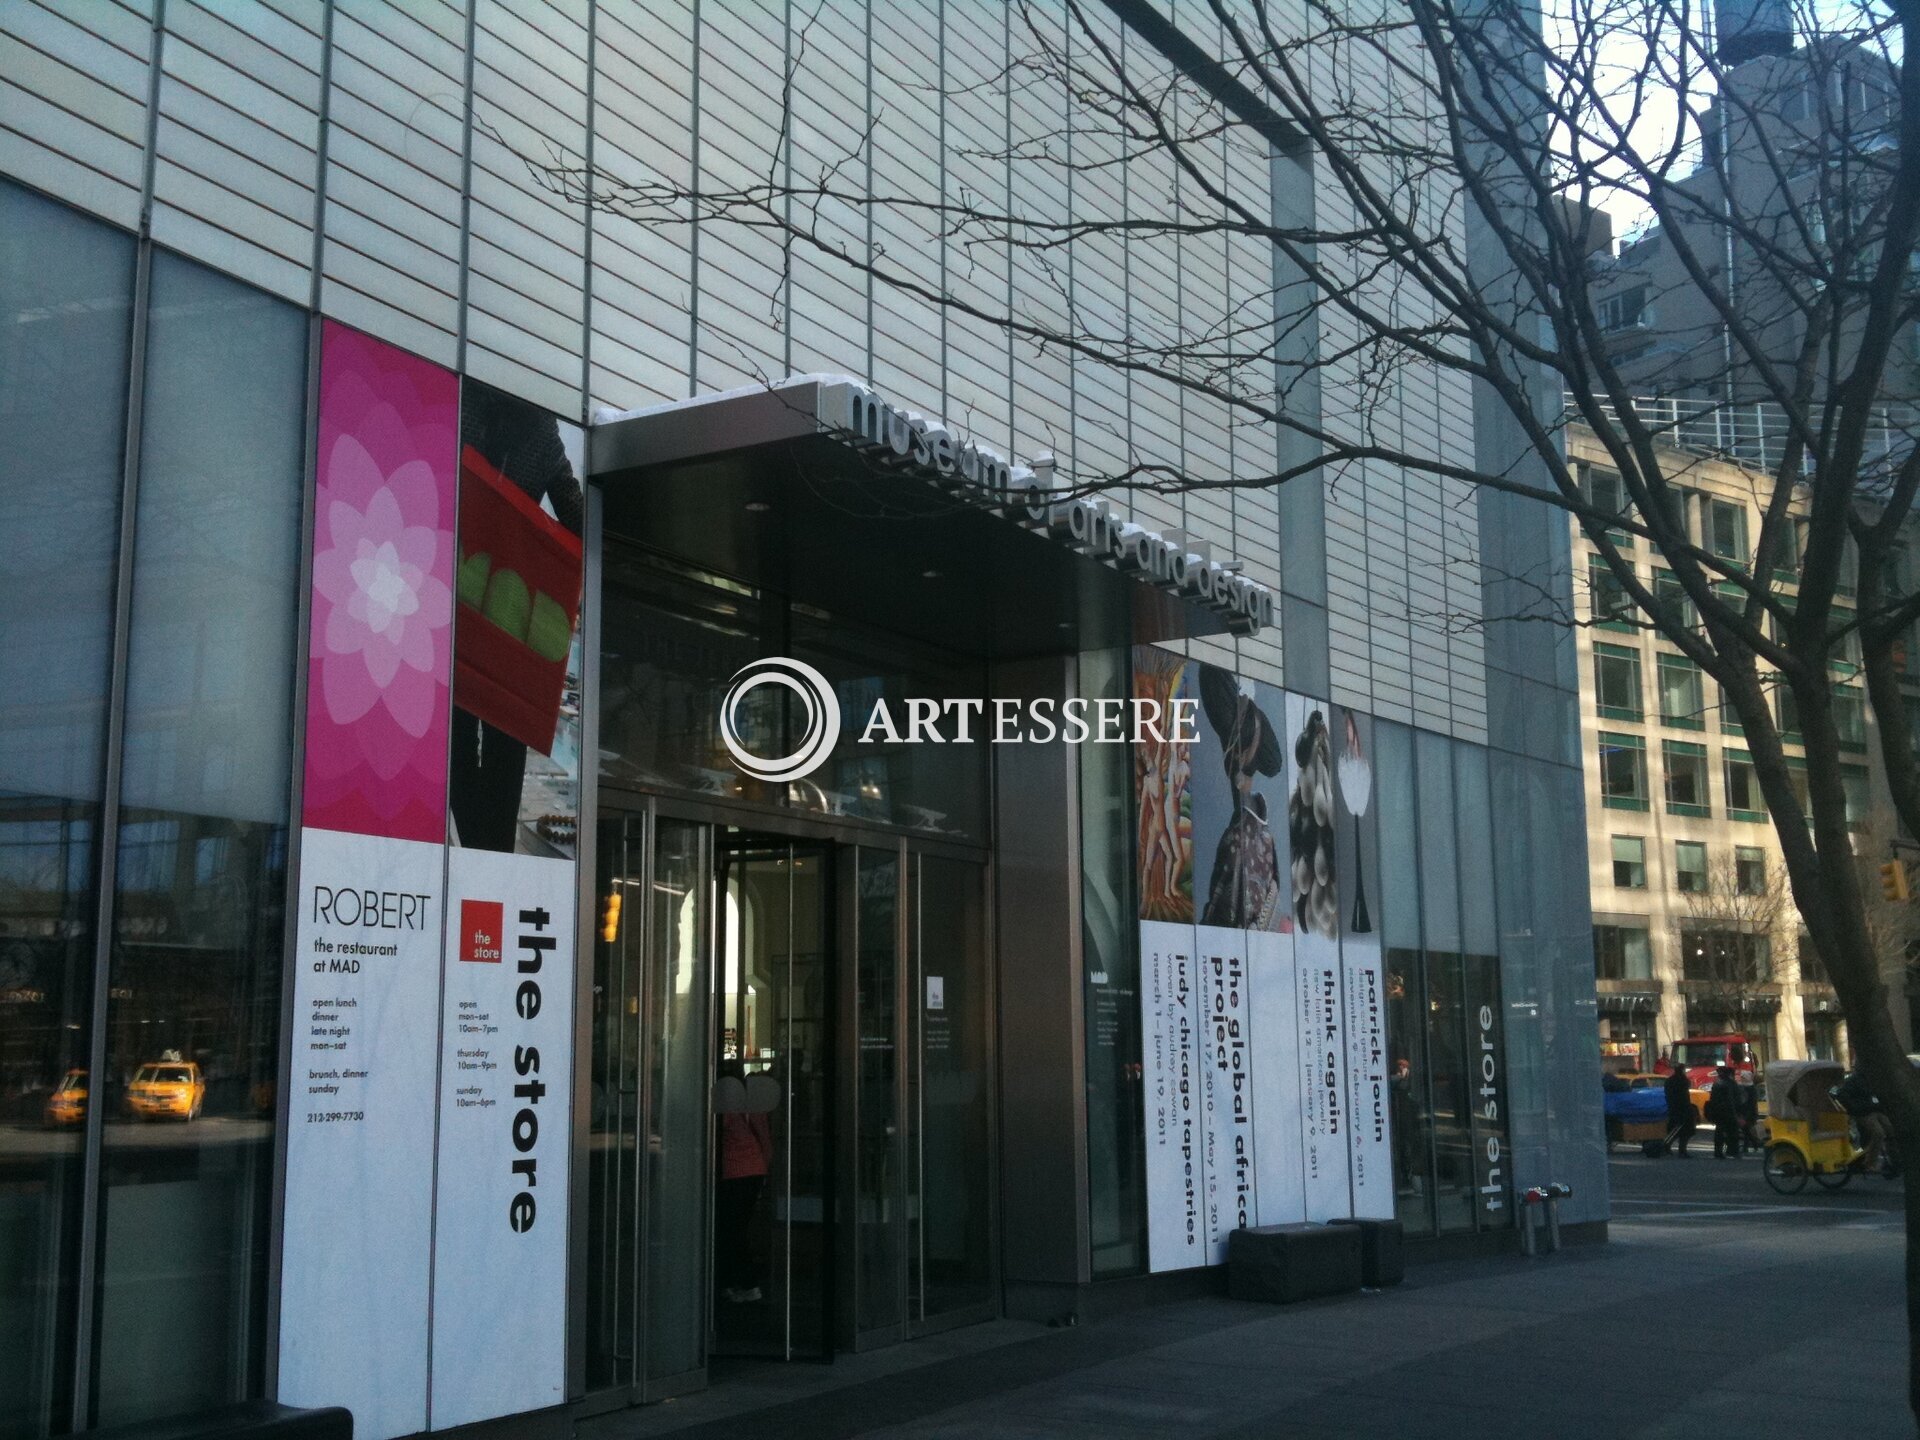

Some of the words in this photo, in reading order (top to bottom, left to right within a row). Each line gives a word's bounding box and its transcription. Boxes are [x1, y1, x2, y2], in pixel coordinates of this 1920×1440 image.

[847, 383, 1012, 504] museum
[1069, 499, 1126, 560] arts
[1136, 528, 1187, 588] and
[1199, 541, 1274, 638] design
[313, 885, 431, 930] ROBERT
[314, 937, 334, 953] the
[336, 942, 398, 956] restaurant
[473, 946, 500, 960] store
[474, 930, 491, 945] the
[515, 907, 556, 1020] the
[313, 960, 326, 973] at
[329, 958, 360, 974] MAD
[1153, 952, 1162, 1004] march
[1175, 954, 1189, 1009] judy
[1229, 957, 1242, 1009] the
[311, 1012, 339, 1021] dinner
[312, 999, 334, 1009] open
[335, 998, 357, 1008] lunch
[458, 1001, 478, 1010] open
[1202, 955, 1211, 1036] november
[1211, 956, 1229, 1072] project
[1323, 969, 1337, 1042] think
[1364, 969, 1382, 1066] patrick
[311, 1026, 328, 1036] late
[329, 1026, 350, 1038] night
[457, 1049, 490, 1059] thursday
[342, 1069, 369, 1078] dinner
[1180, 1016, 1191, 1111] chicago
[1228, 1018, 1248, 1124] global
[1479, 1004, 1498, 1121] store
[308, 1084, 339, 1095] sunday
[456, 1086, 483, 1096] sunday
[1205, 1070, 1214, 1112] 2010
[1325, 1051, 1340, 1135] again
[1369, 1075, 1385, 1142] jouin
[510, 1044, 546, 1234] store
[1157, 1107, 1166, 1145] 2011
[1208, 1131, 1216, 1168] May
[1181, 1118, 1196, 1246] tapestries
[1235, 1134, 1249, 1229] africa
[1482, 1137, 1503, 1212] the
[1210, 1203, 1219, 1244] 2011
